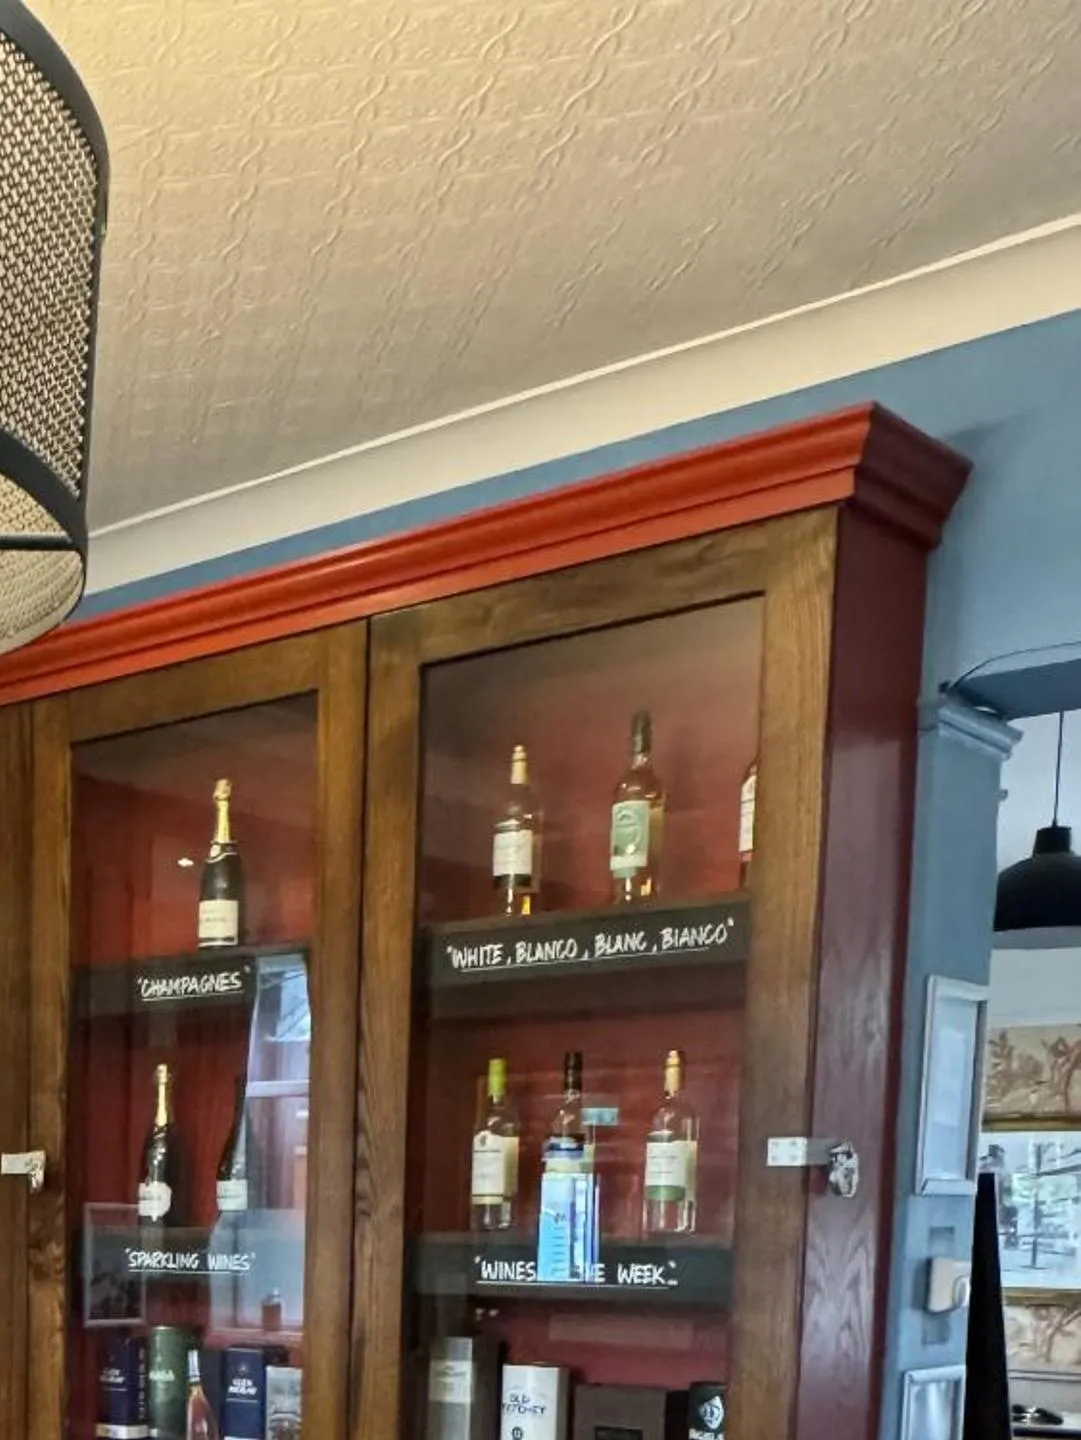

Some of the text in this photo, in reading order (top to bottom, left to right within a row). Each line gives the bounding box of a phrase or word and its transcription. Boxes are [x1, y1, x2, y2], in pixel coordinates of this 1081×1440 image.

[515, 938, 589, 963] BLANCO,
[594, 930, 658, 959] BLANC,
[124, 1247, 257, 1271] "SPARKLING WINES"
